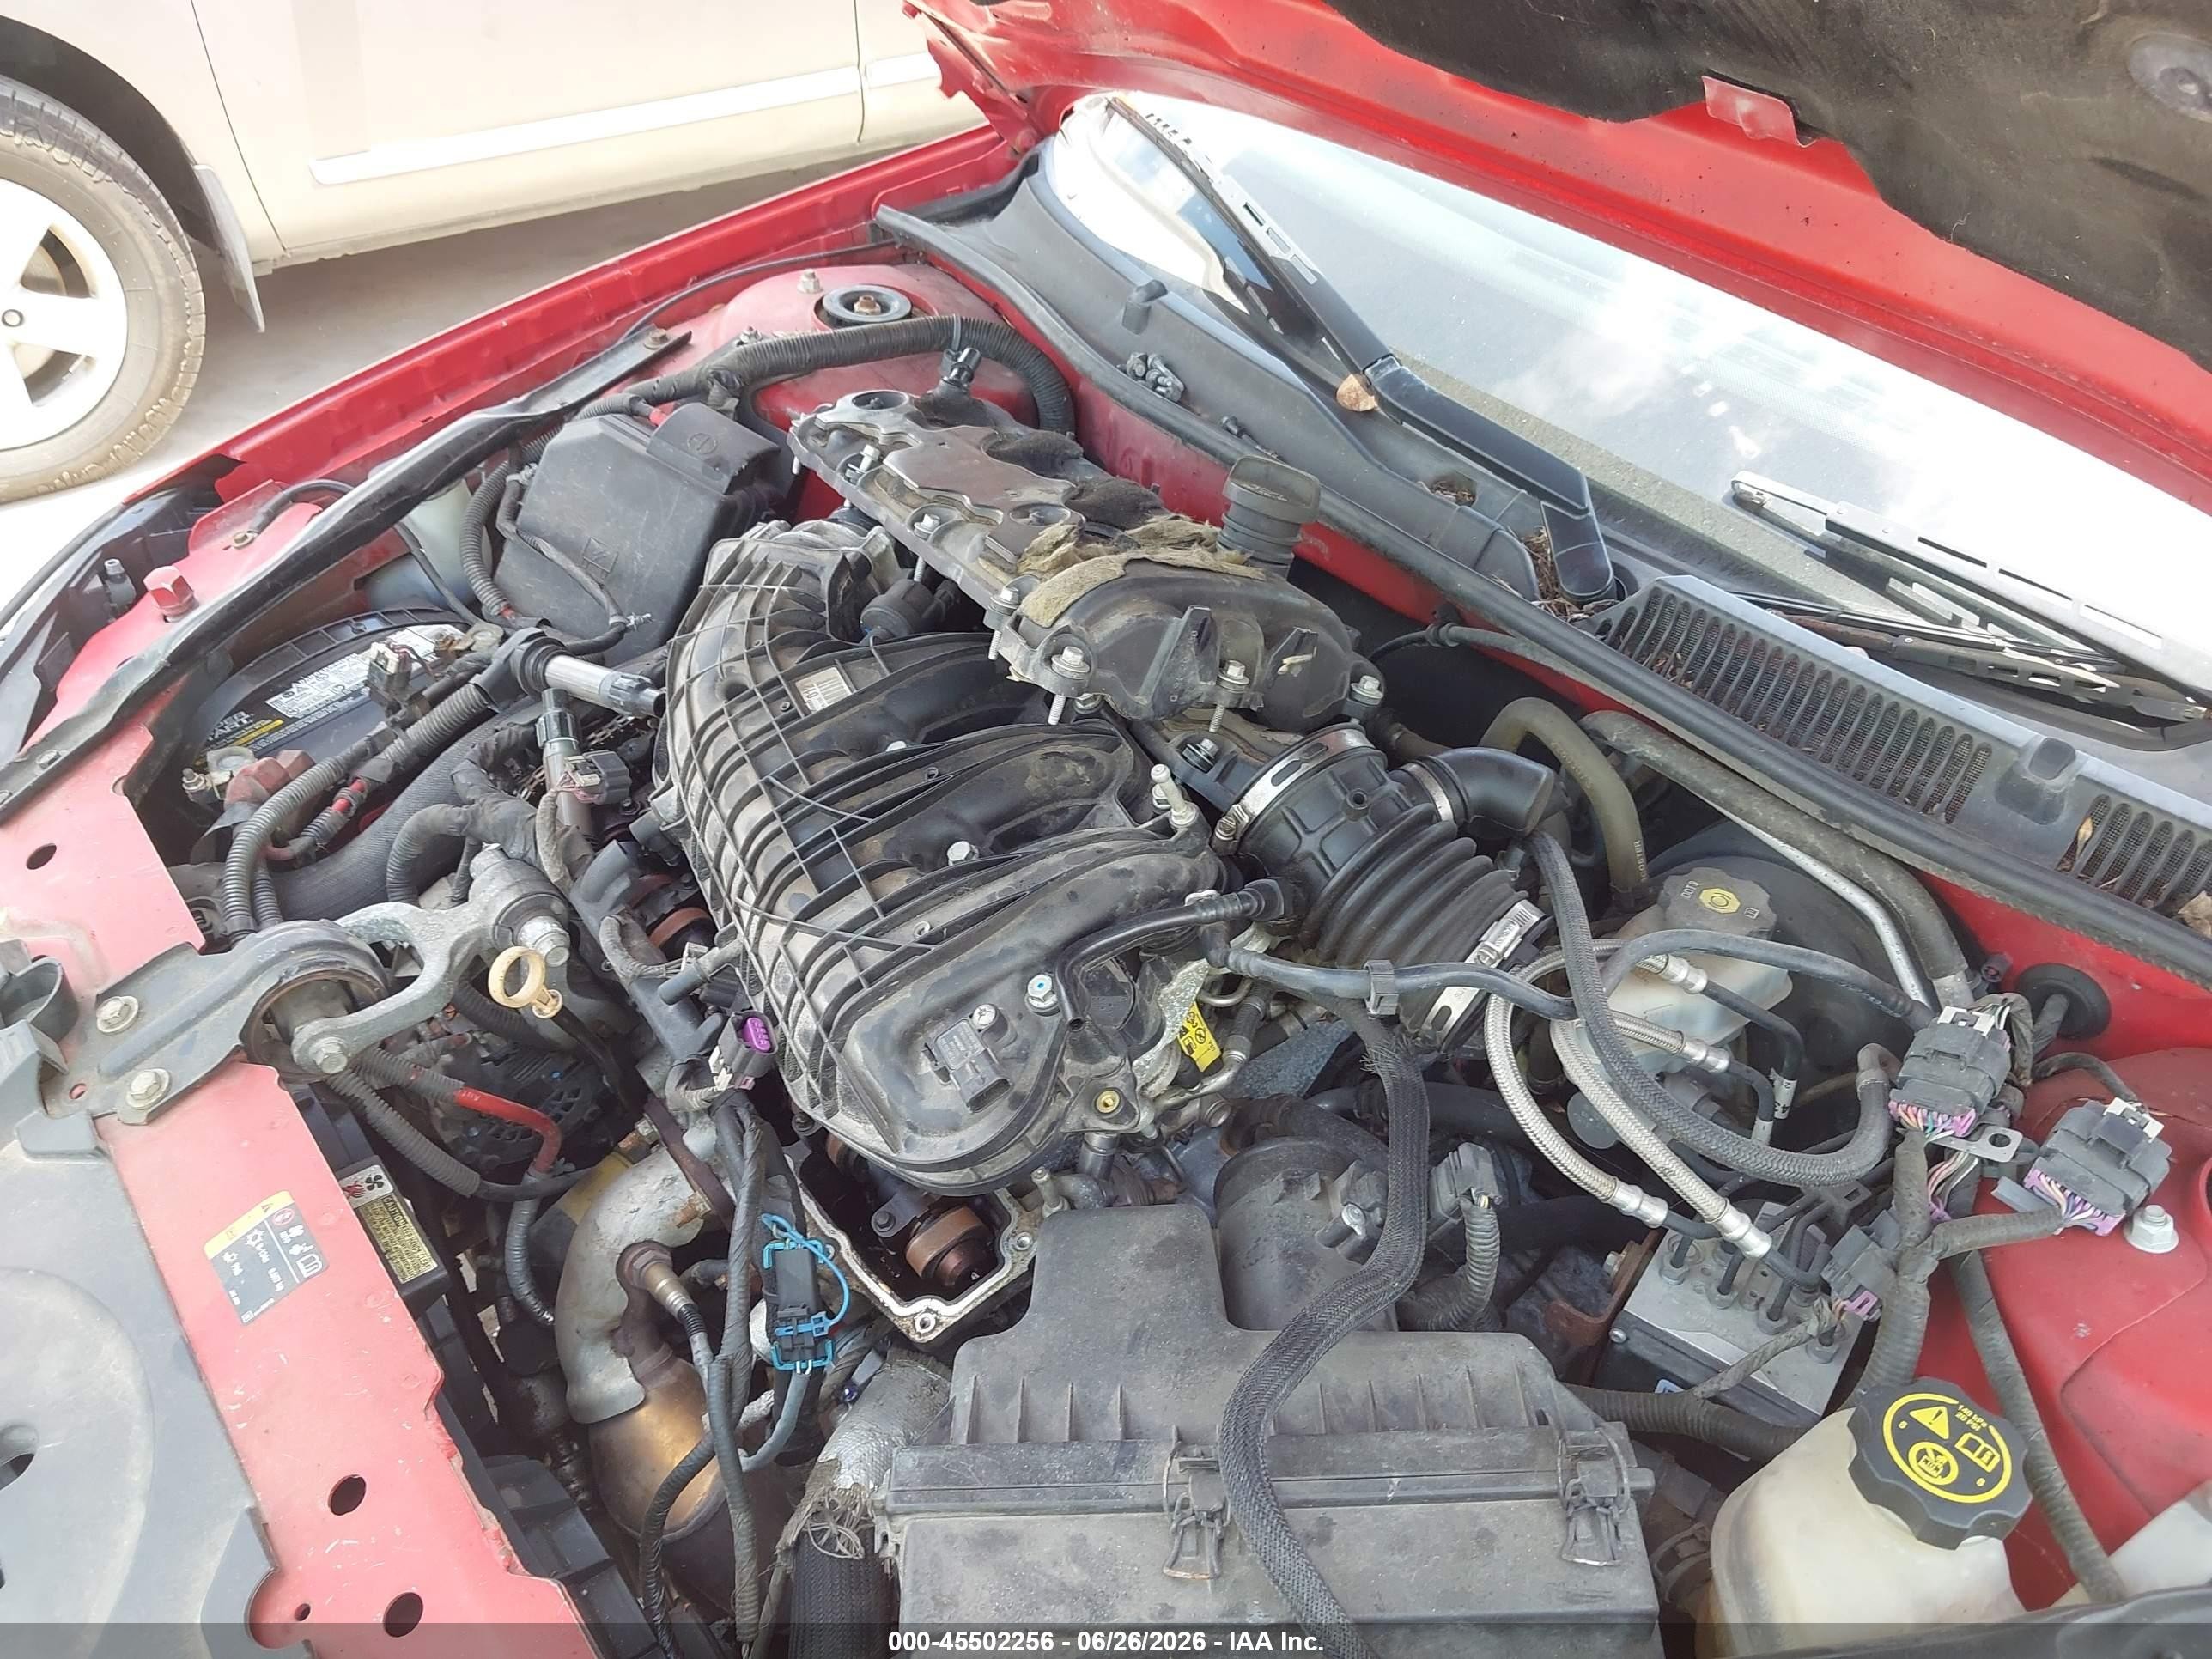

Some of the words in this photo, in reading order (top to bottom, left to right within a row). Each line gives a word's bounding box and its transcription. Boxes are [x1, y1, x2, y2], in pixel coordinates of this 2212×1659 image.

[383, 1196, 408, 1226] CAUTION
[1958, 1404, 1973, 1417] 140
[1954, 1411, 1967, 1422] 20
[1966, 1419, 1981, 1431] PSI
